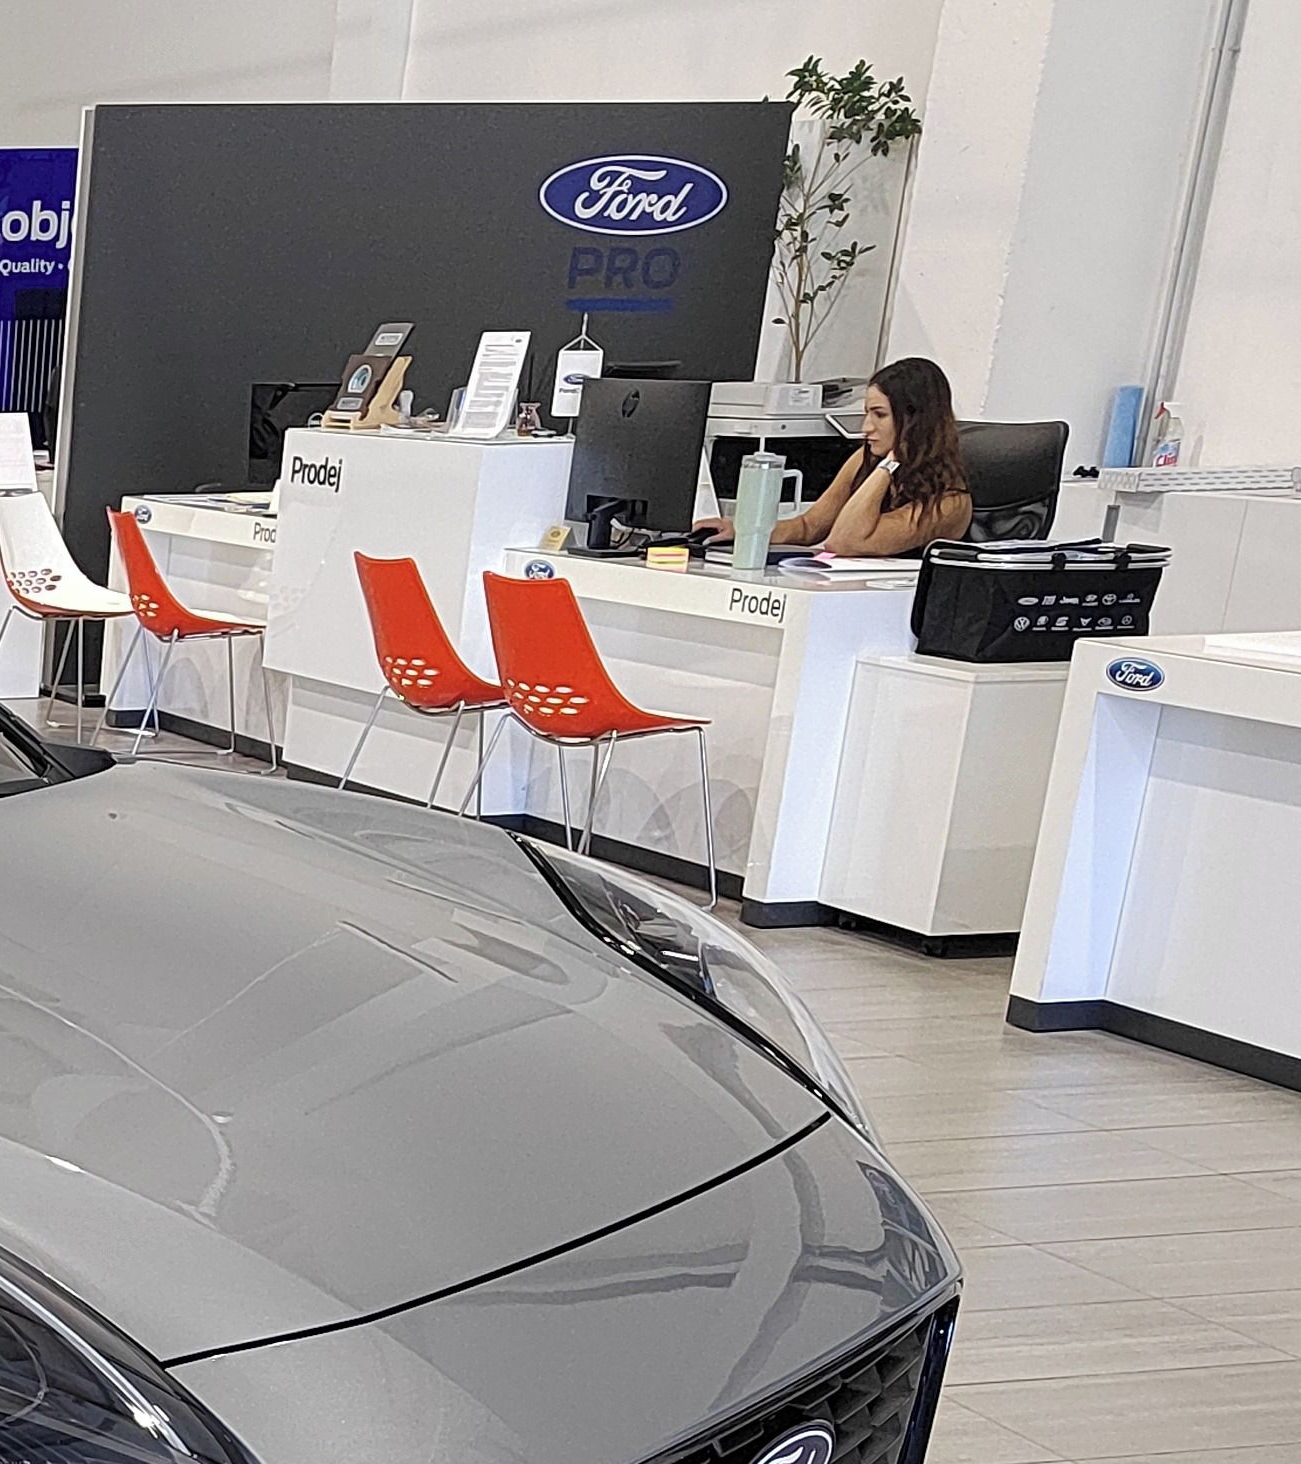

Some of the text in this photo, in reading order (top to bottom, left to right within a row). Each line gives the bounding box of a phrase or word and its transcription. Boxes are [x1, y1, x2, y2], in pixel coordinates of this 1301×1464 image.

[575, 165, 694, 222] Ford
[1, 200, 73, 249] obj
[0, 258, 55, 276] Quality
[567, 246, 681, 290] PRO
[290, 455, 343, 493] Prodej
[729, 587, 787, 624] Prodej
